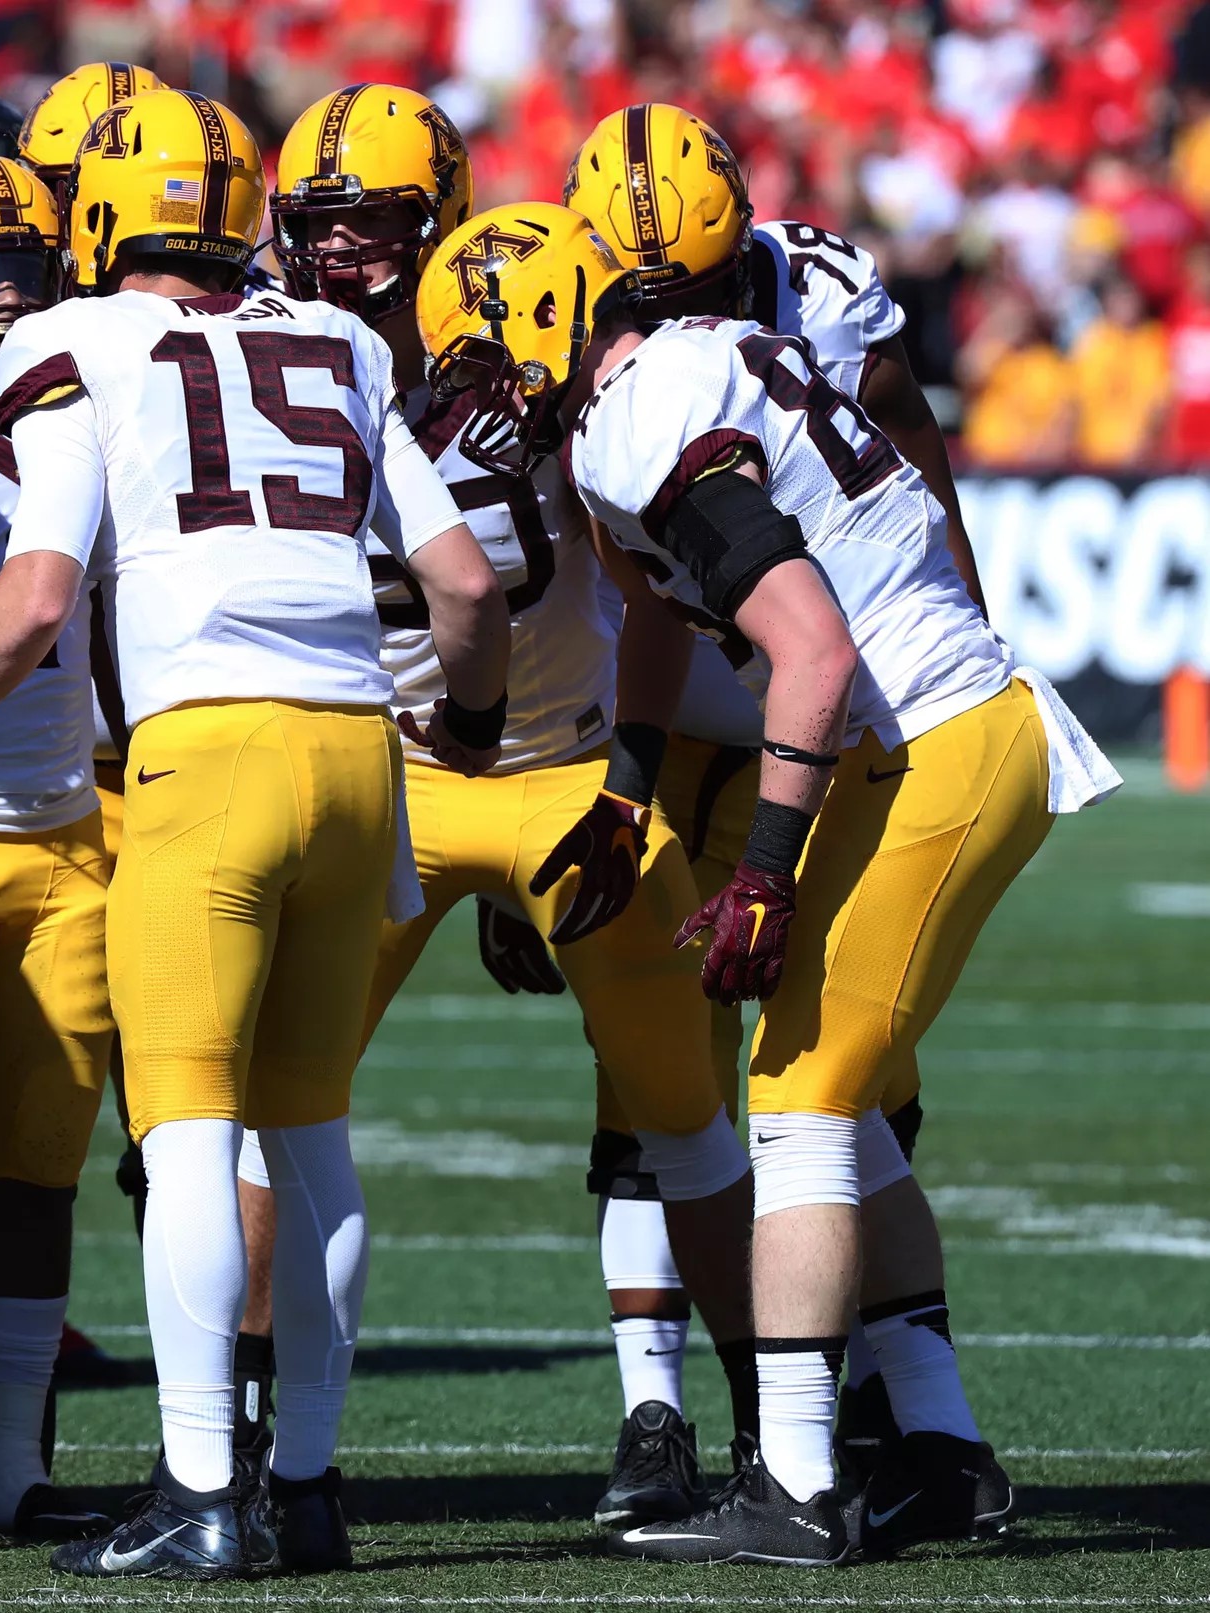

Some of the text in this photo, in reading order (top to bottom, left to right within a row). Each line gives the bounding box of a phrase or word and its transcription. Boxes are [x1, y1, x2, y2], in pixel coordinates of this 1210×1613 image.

[196, 100, 225, 162] SKI-U-MAH
[322, 94, 352, 160] SKI-U-MAH
[309, 178, 343, 188] GOPHERS
[632, 162, 656, 242] SKI-U-MAH
[165, 238, 199, 251] GOLD
[150, 329, 374, 537] 15
[789, 1516, 831, 1538] ALPHA
